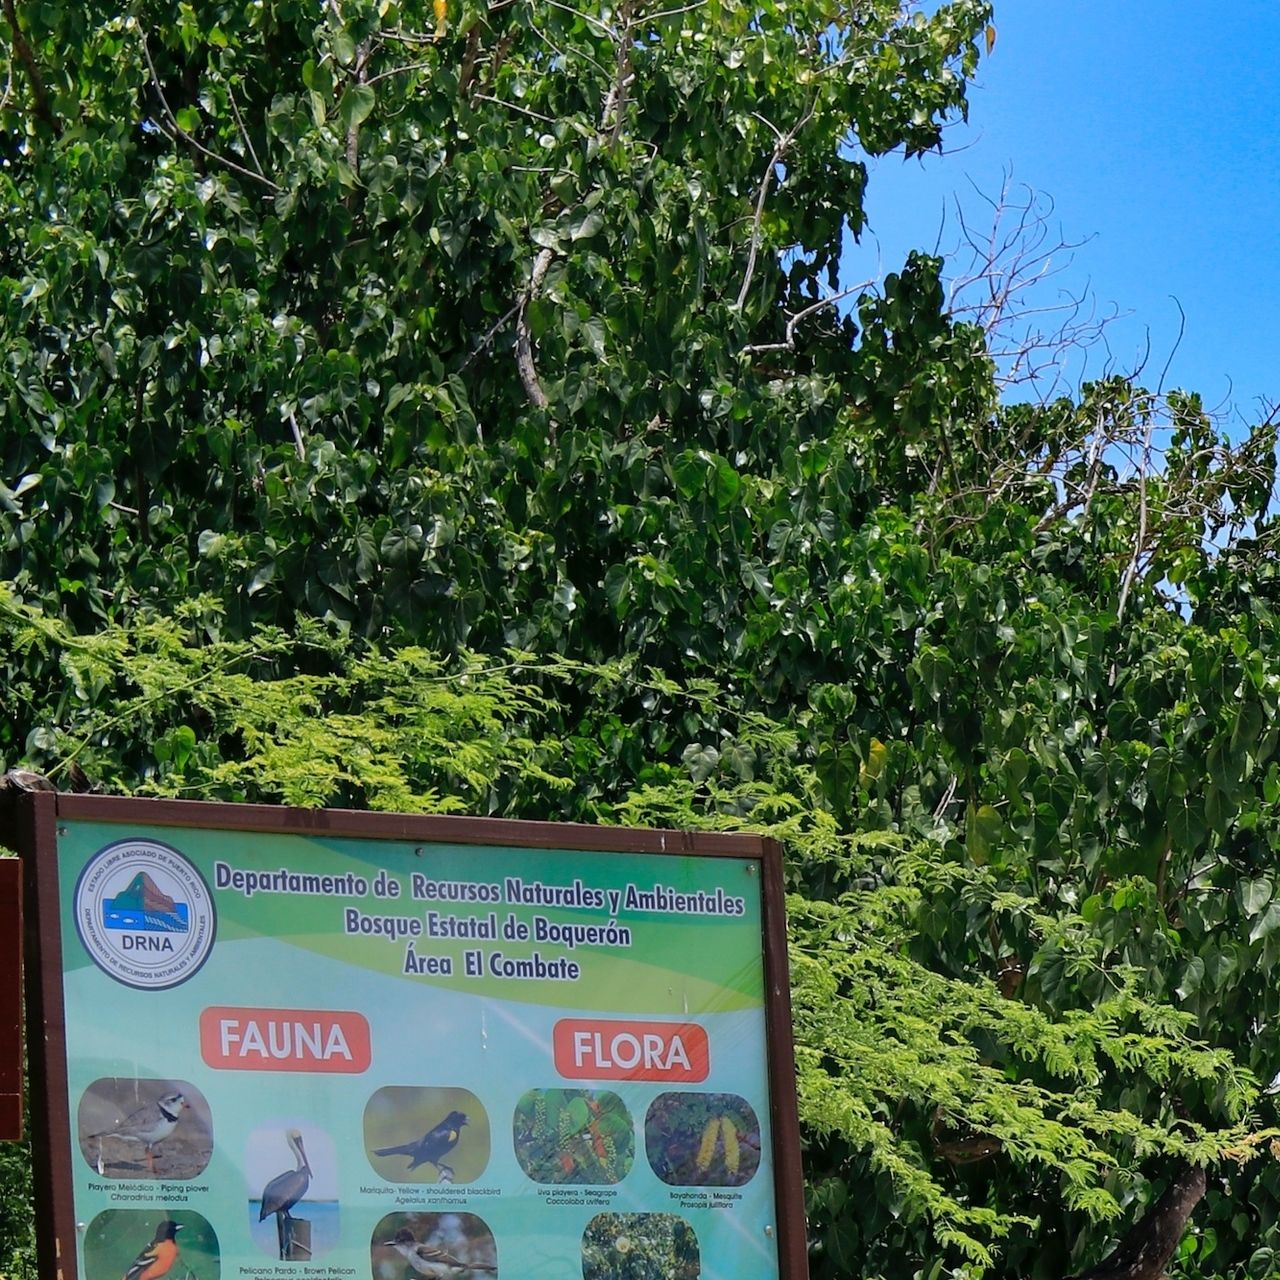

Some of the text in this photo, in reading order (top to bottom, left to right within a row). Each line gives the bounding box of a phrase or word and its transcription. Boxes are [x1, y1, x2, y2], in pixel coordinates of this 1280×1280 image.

[88, 850, 200, 899] ESTADO LIBRE ASOCIADO DE PUERTO RICO
[215, 862, 744, 915] Departamento de Recursos Naturales y Ambientales
[85, 908, 110, 959] DEPARTAMENTO
[110, 957, 119, 968] DE
[118, 963, 153, 979] RECURSOS
[154, 960, 187, 979] NATURALES
[190, 915, 205, 958] AMBIENTALES
[122, 935, 174, 952] DRNA
[345, 908, 631, 948] Bosque Estatal de Boquerón
[404, 942, 580, 980] Área El Combate
[220, 1019, 353, 1060] FAUNA
[574, 1032, 691, 1070] FLORA
[155, 1194, 188, 1202] melodus
[161, 1184, 184, 1193] Piping
[426, 1187, 465, 1195] shouldered
[467, 1187, 501, 1195] blackbird
[670, 1192, 707, 1200] Bayahonda
[275, 1267, 296, 1275] Pardo
[304, 1267, 326, 1275] Brown
